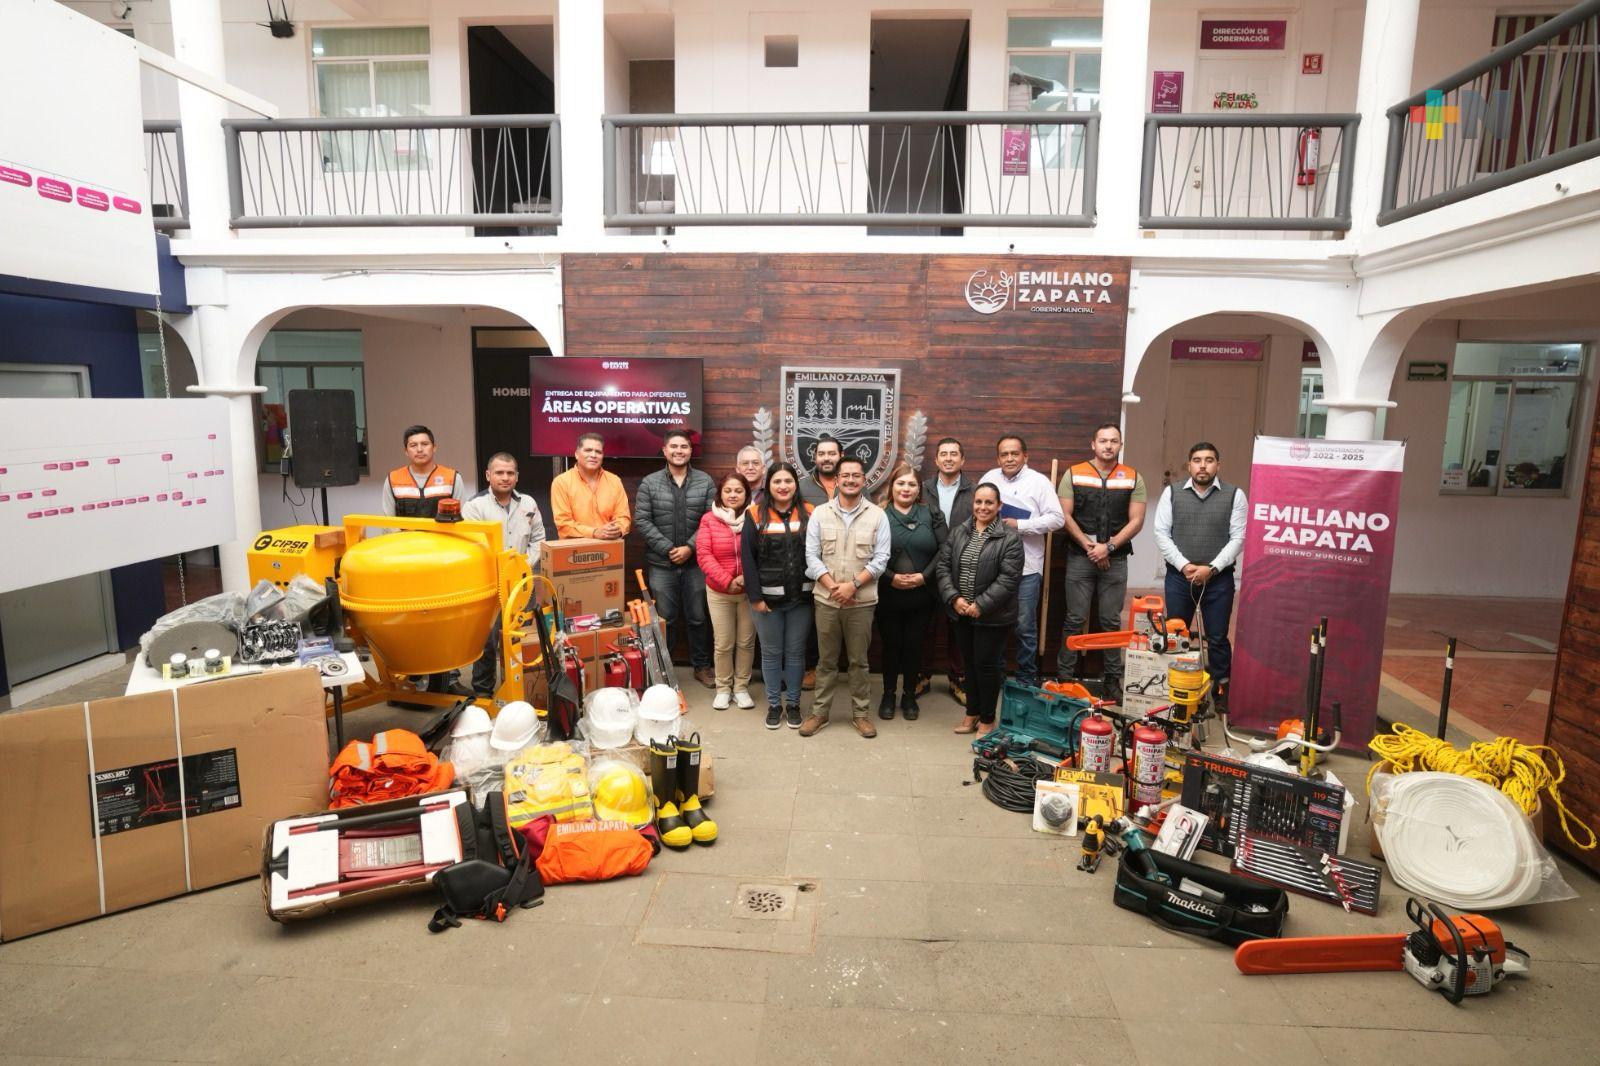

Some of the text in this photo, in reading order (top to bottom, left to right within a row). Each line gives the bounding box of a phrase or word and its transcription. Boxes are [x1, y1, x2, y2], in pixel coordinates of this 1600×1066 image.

[1212, 27, 1256, 35] DIRECCIÓN
[1213, 100, 1259, 109] NAVIDAD
[1019, 272, 1112, 286] EMILIANO
[1019, 289, 1111, 303] ZAPATA
[1188, 346, 1244, 354] INTENDENCIA
[795, 373, 886, 383] EMILIANO ZAPATA
[492, 387, 531, 397] HOMB
[584, 390, 631, 398] EQUIPAENTO
[542, 396, 691, 415] ÁREAS OPERATIVAS
[884, 387, 894, 445] VERACRUZ
[785, 414, 794, 436] DOS
[784, 444, 802, 475] TIERR
[1312, 452, 1334, 460] 2022
[1342, 453, 1364, 461] 2025
[1253, 503, 1390, 532] EMILIANO
[271, 539, 309, 550] CIPSA
[1262, 524, 1374, 553] ZAPATA
[1268, 547, 1365, 564] GOBIERNO MUNICIPAL
[1203, 760, 1249, 779] TRUPER
[1312, 790, 1328, 802] 119
[556, 820, 629, 834] EMILIANO ZAPATA
